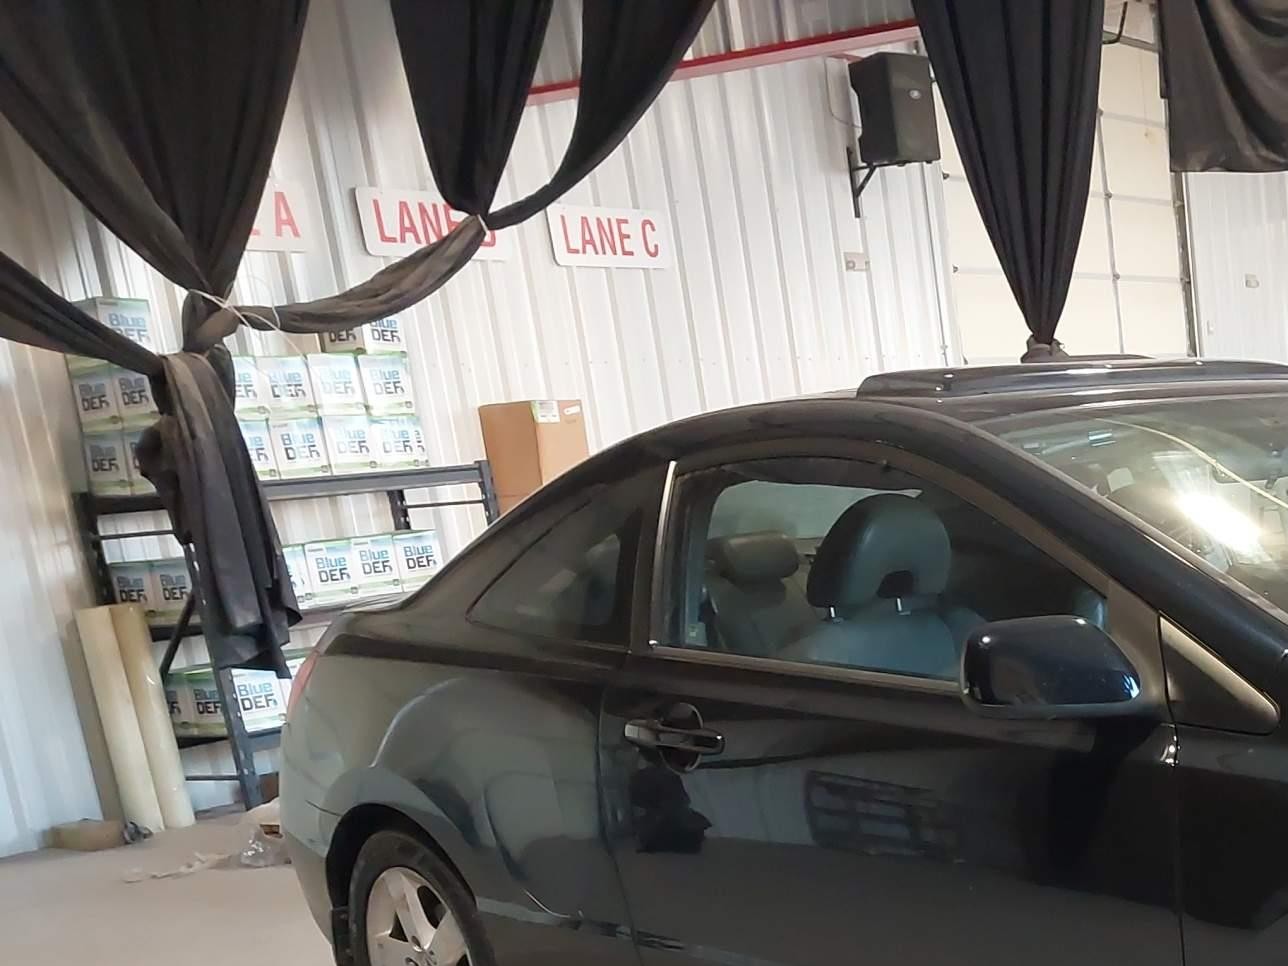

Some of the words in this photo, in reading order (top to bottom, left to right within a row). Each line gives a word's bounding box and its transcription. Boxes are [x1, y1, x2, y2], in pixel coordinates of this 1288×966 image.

[274, 191, 301, 238] A
[560, 214, 635, 256] LANE
[641, 219, 659, 258] C
[359, 549, 390, 562] Blue
[403, 545, 434, 558] Blue
[315, 556, 347, 569] Blue
[237, 682, 273, 697] Blue
